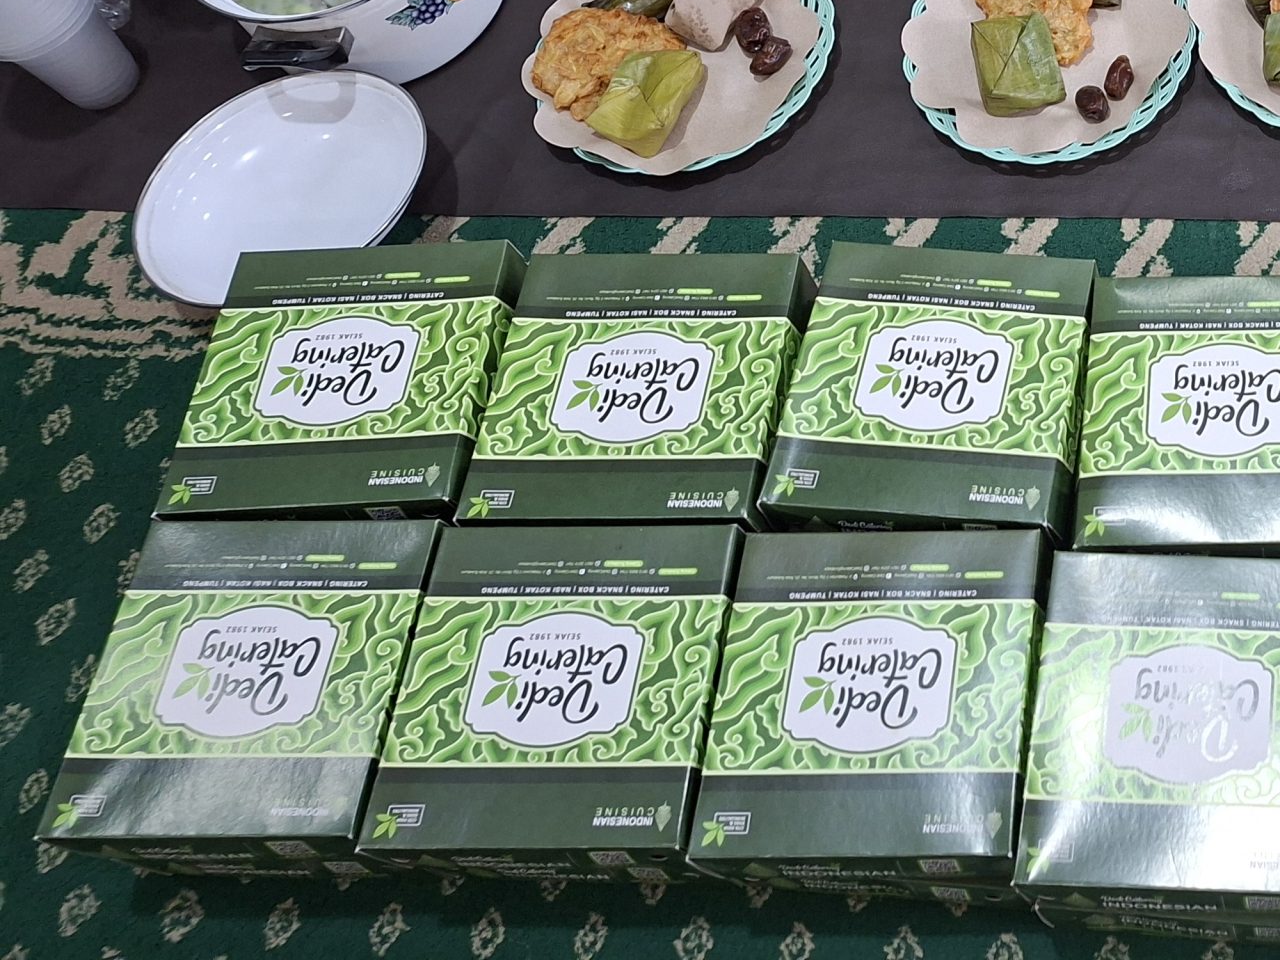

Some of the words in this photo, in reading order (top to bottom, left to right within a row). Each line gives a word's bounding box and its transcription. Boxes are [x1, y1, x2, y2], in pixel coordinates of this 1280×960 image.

[867, 292, 901, 301] TUMPENG
[906, 295, 931, 303] KOTAK
[970, 300, 995, 308] SNACK
[999, 302, 1035, 311] CATERING
[290, 337, 405, 374] Catering
[887, 337, 999, 384] Catering
[585, 352, 699, 392] Catering
[299, 369, 377, 407] Dedi
[898, 375, 973, 414] Dedi
[595, 387, 672, 424] Dedi
[1191, 399, 1269, 437] Dedi
[371, 468, 426, 478] CUISINE
[368, 475, 425, 486] INDONESIAN
[669, 491, 725, 499] CUISINE
[971, 485, 1025, 496] CUISINE
[969, 492, 1024, 504] INDONESIAN
[667, 499, 724, 507] INDONESIAN
[481, 585, 519, 593] TUMPENG
[524, 585, 552, 593] KOTAK
[552, 585, 572, 593] NASI
[596, 585, 623, 593] SNACK
[937, 589, 978, 597] CATERING
[789, 591, 826, 599] TUMPENG
[832, 590, 860, 599] KOTAK
[860, 590, 880, 598] NASI
[886, 590, 903, 598] BOX
[904, 590, 931, 598] SNACK
[841, 638, 863, 646] 1982
[197, 629, 321, 677] Catering
[503, 636, 628, 685] Catering
[817, 642, 942, 690] Catering
[204, 671, 287, 716] Dedi
[514, 679, 598, 724] Dedi
[832, 684, 918, 730] Dedi
[595, 806, 655, 815] CUISINE
[592, 815, 654, 825] INDONESIAN
